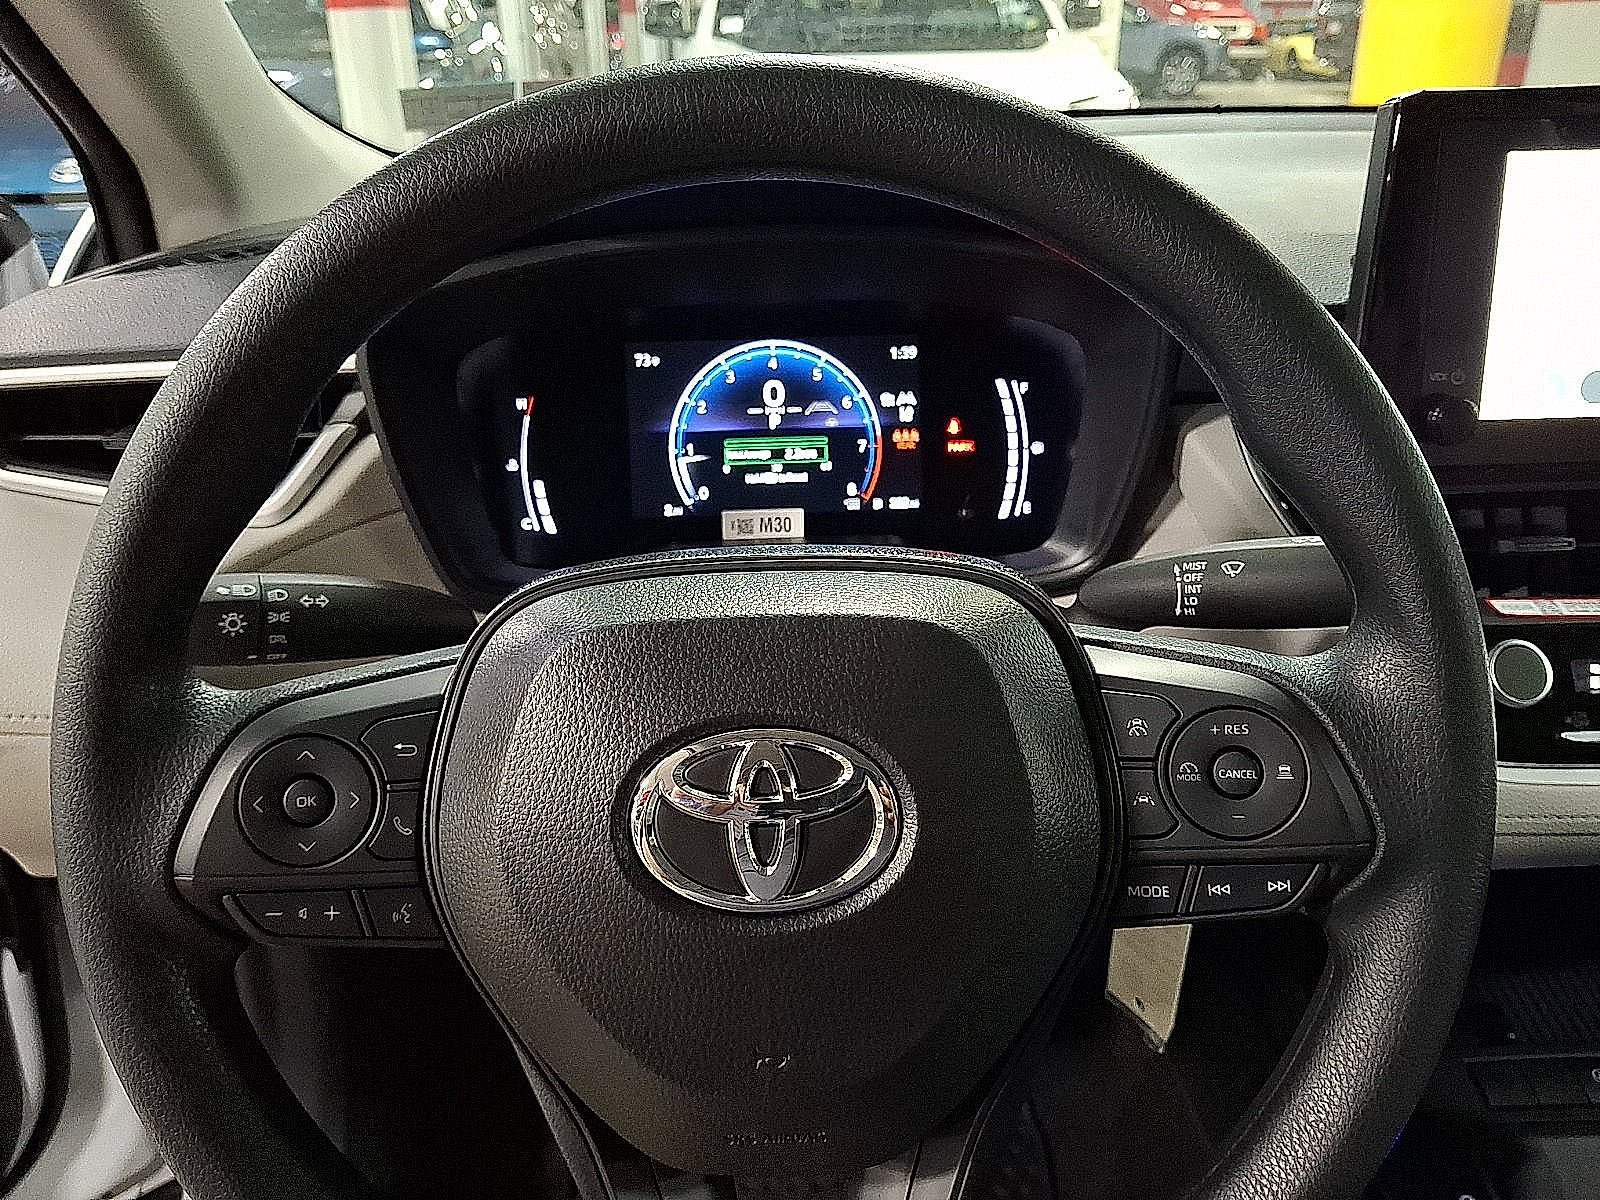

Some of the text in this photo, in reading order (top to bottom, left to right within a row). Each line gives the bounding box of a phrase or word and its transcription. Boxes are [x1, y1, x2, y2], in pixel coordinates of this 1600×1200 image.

[767, 356, 778, 370] 4
[725, 370, 736, 384] 3
[812, 367, 823, 382] 5
[762, 379, 786, 408] 0
[696, 400, 708, 415] 2
[841, 396, 853, 410] 6
[686, 443, 694, 457] 1
[856, 439, 867, 454] 7
[759, 517, 792, 533] M30
[1182, 561, 1208, 572] MIST
[1183, 572, 1205, 583] OFF
[1184, 584, 1203, 594] INT
[1183, 596, 1198, 606] LO
[1183, 607, 1196, 616] HI
[1176, 774, 1202, 782] MODE
[1218, 769, 1258, 780] CANCEL
[296, 796, 317, 808] OK
[1127, 885, 1170, 898] MODE
